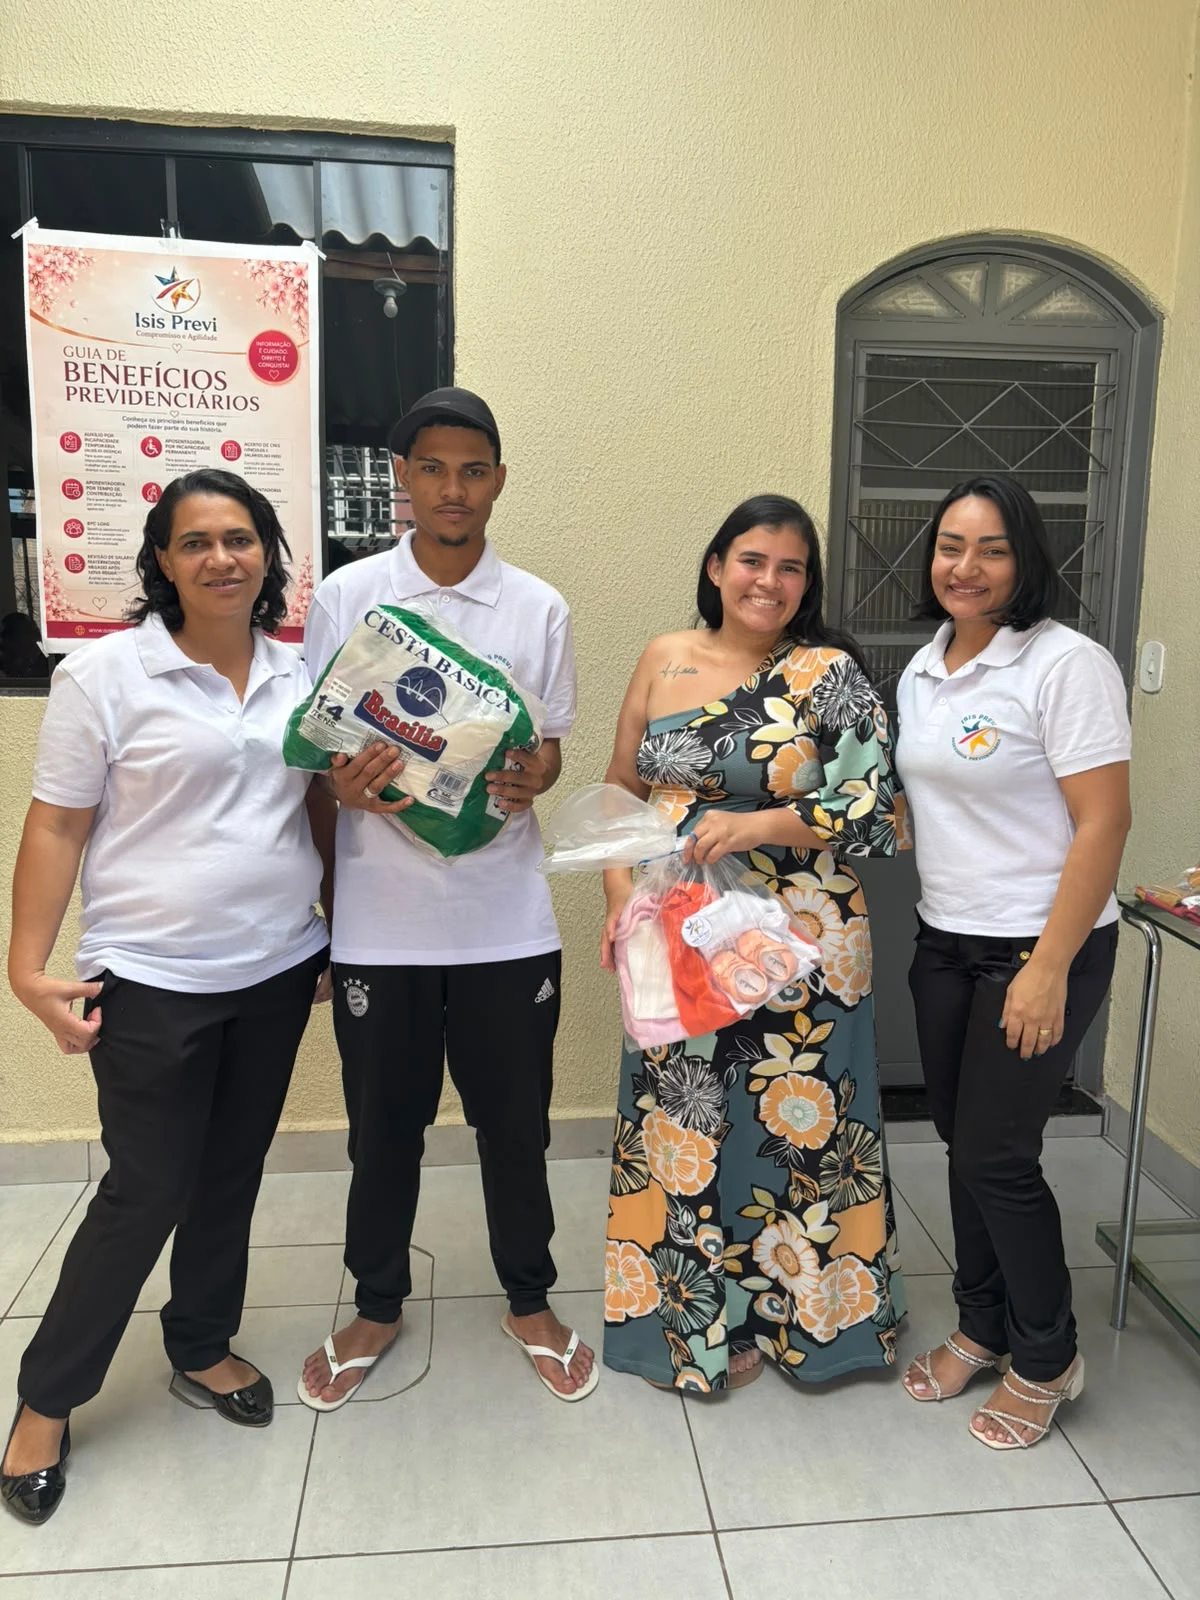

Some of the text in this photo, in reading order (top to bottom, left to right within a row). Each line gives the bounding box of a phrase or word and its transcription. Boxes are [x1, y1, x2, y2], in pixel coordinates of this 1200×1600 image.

[136, 313, 217, 332] Isis Previ
[136, 330, 181, 340] Compromisso
[188, 333, 218, 342] Agilidade
[63, 346, 126, 361] GUIA DE
[64, 361, 228, 391] BENEFÍCIOS
[66, 386, 260, 412] PREVIDENCIÁRIOS
[364, 609, 512, 714] CESTA BÁSICA
[311, 708, 337, 728] ITENS
[318, 694, 344, 722] 14
[364, 689, 446, 752] Brasília
